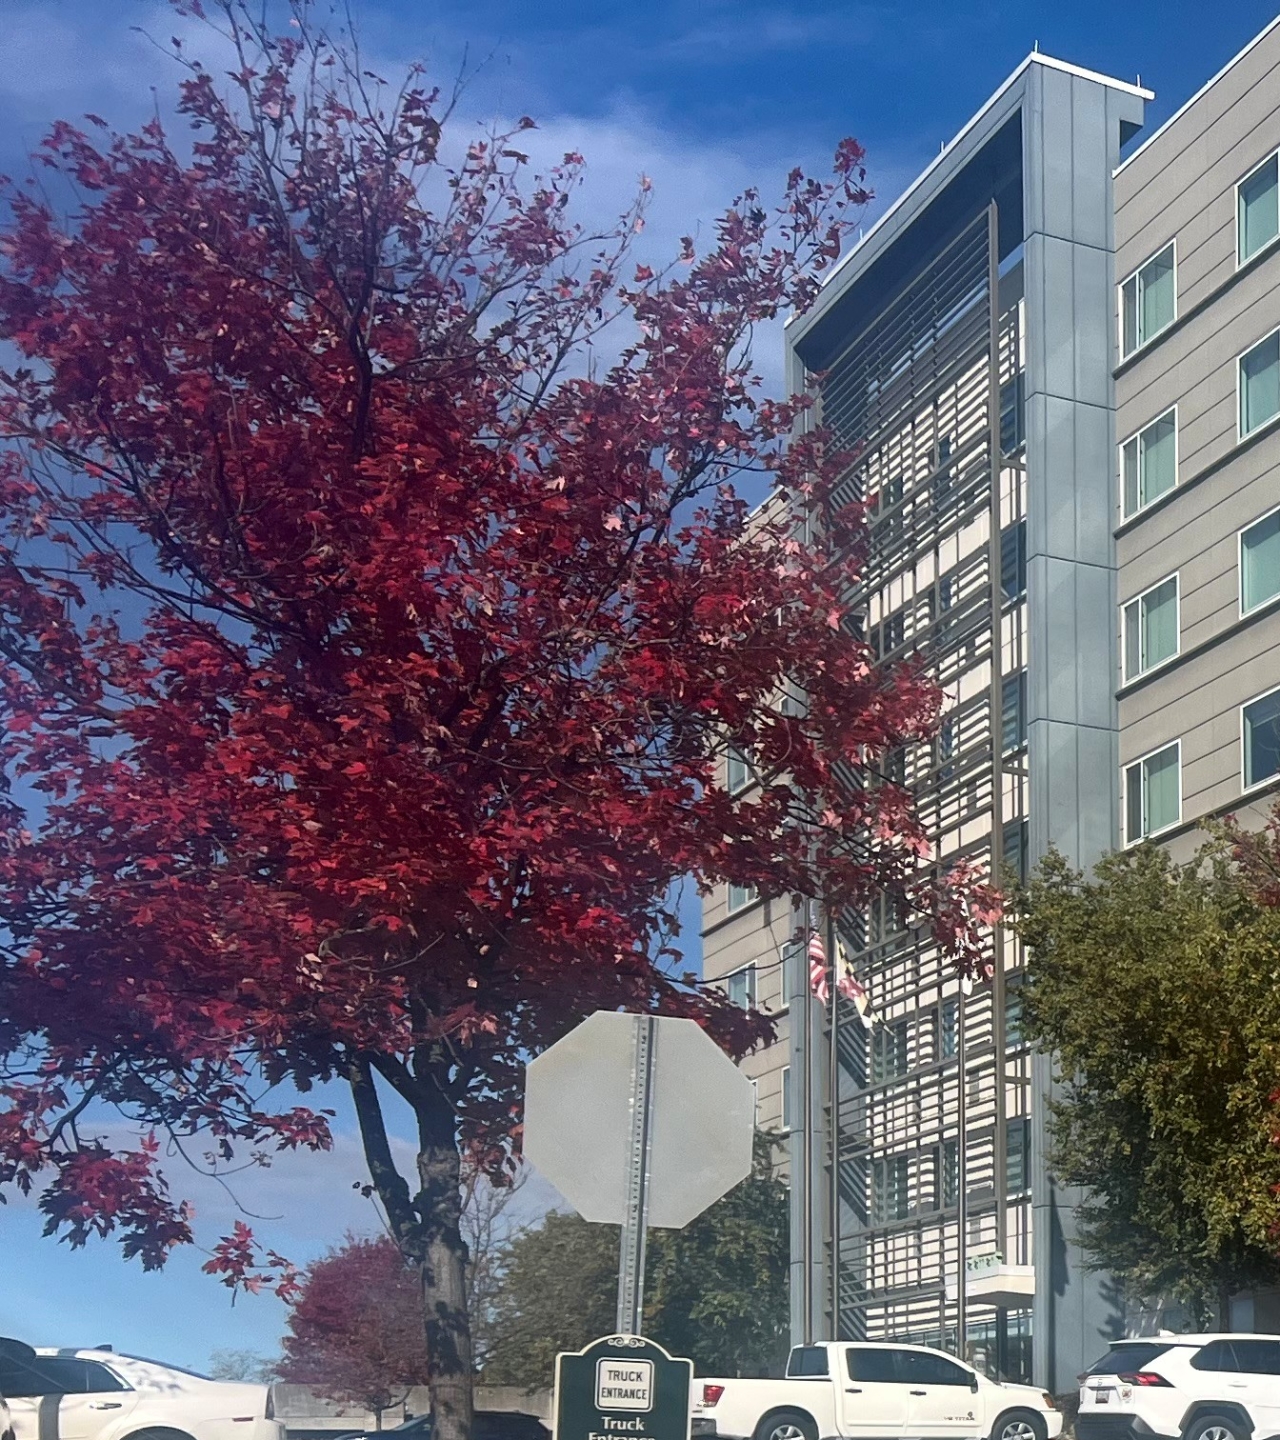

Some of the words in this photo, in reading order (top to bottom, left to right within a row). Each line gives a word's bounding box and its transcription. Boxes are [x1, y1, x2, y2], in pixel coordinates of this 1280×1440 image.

[607, 1369, 643, 1382] TRUCK
[601, 1387, 647, 1400] ENTRANCE
[601, 1416, 645, 1431] Truck
